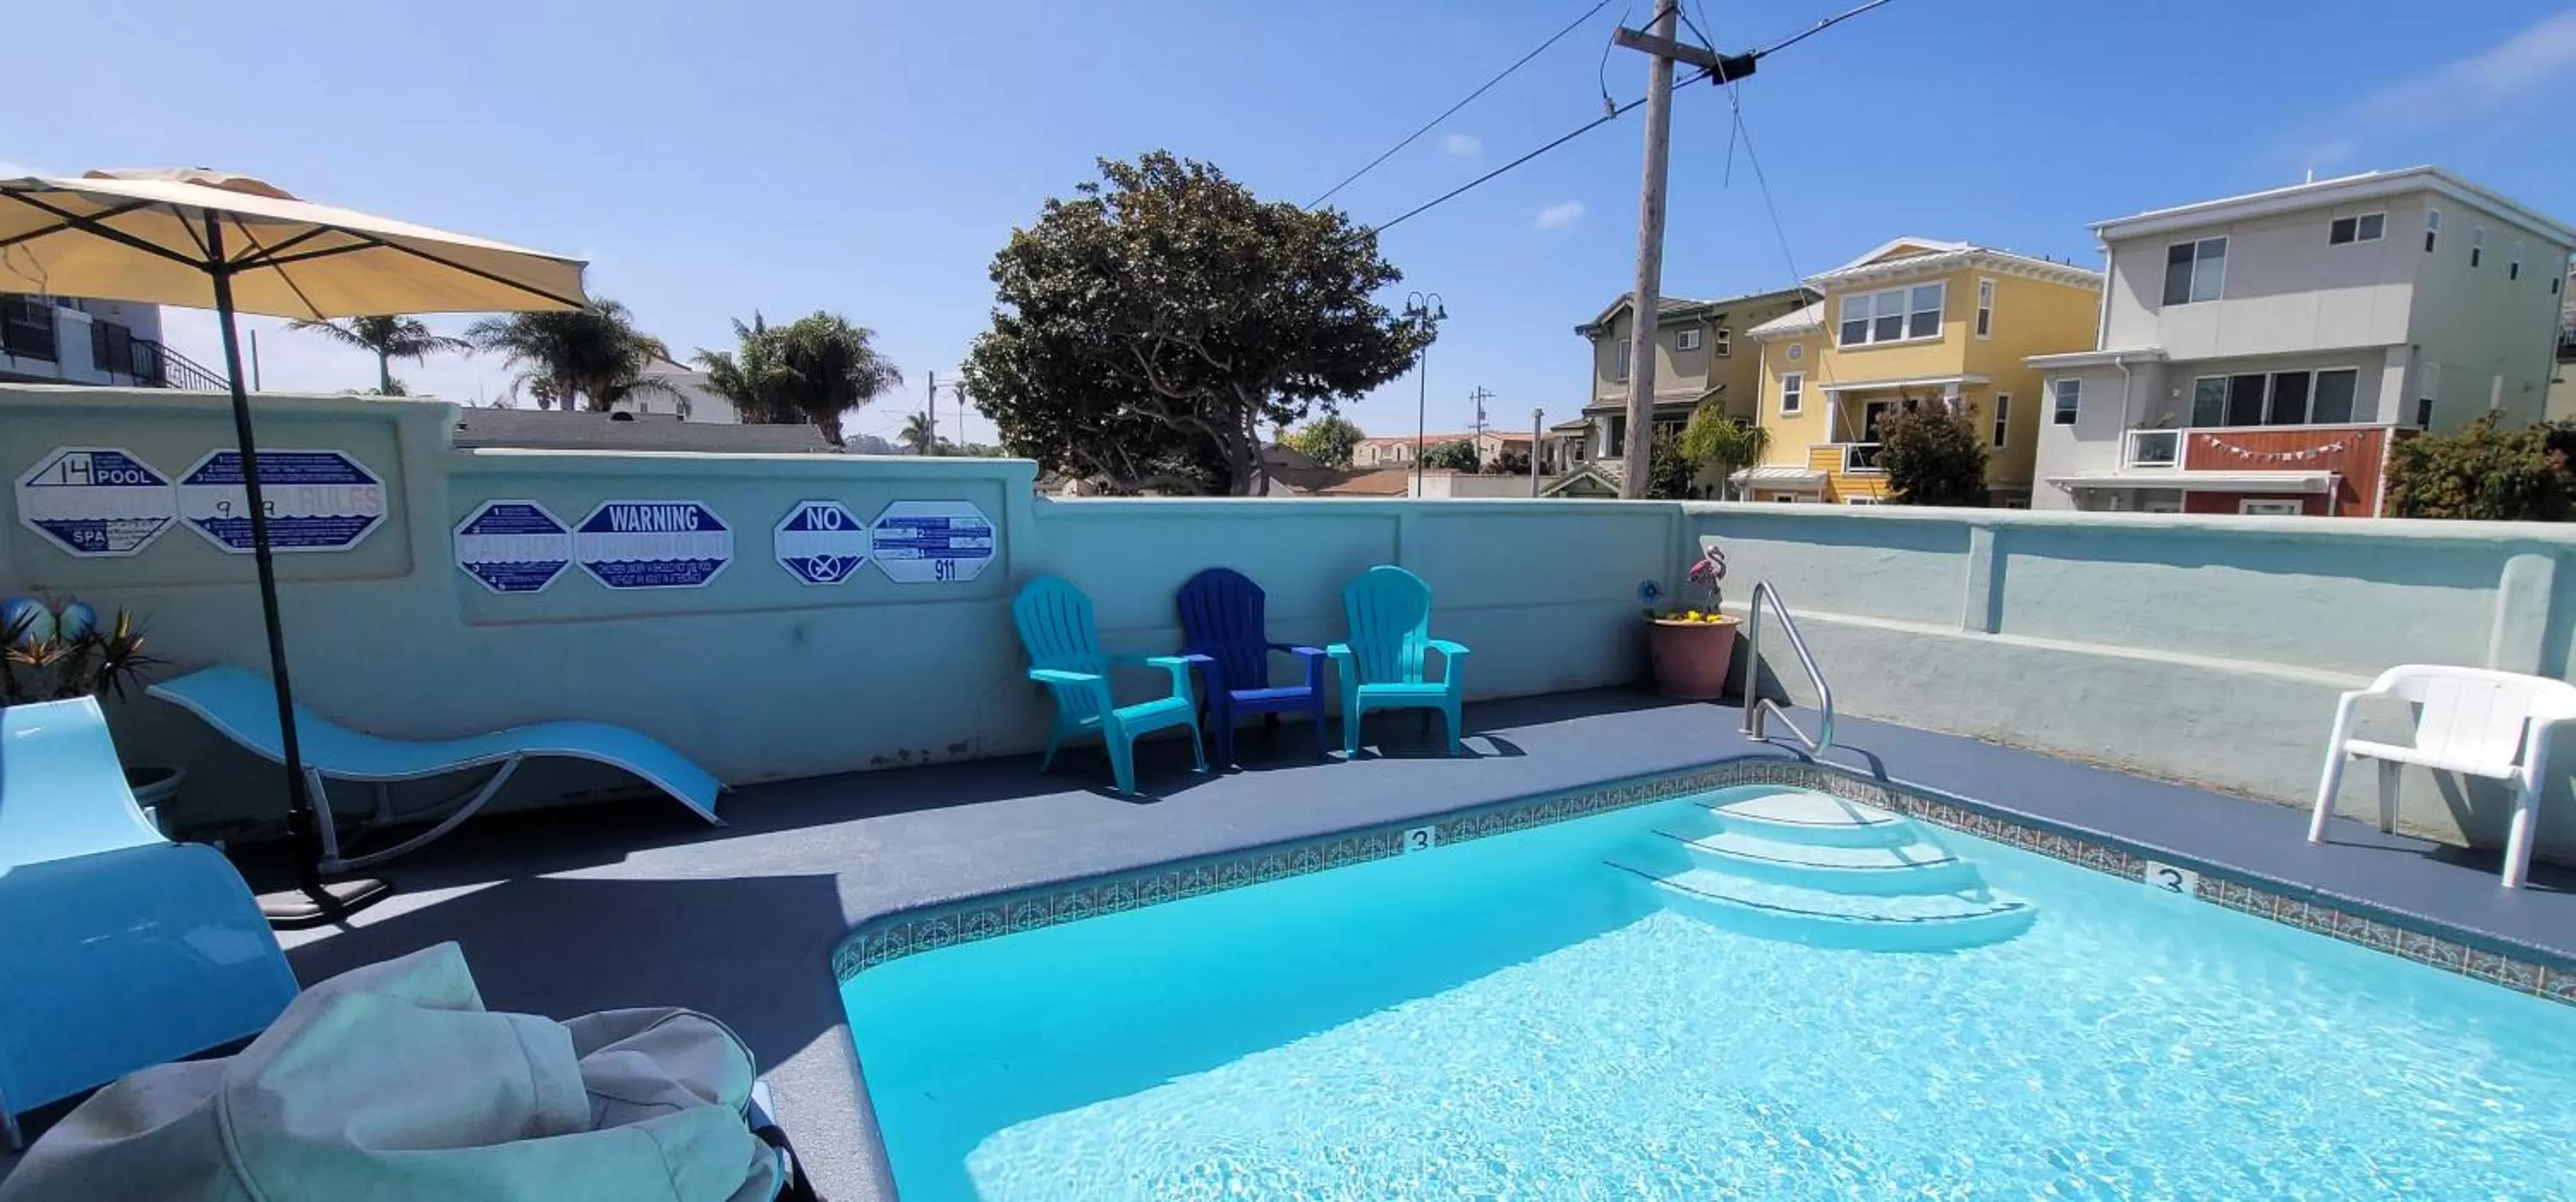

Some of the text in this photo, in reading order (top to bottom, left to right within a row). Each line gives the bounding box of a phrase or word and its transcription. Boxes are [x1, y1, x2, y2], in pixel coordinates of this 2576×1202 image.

[61, 459, 91, 483] 14
[97, 470, 151, 483] POOL
[609, 507, 698, 531] WARNING
[806, 508, 841, 530] NO
[73, 531, 105, 543] SPA
[935, 559, 956, 580] 911
[1411, 830, 1429, 852] 3
[2157, 868, 2184, 893] 3
